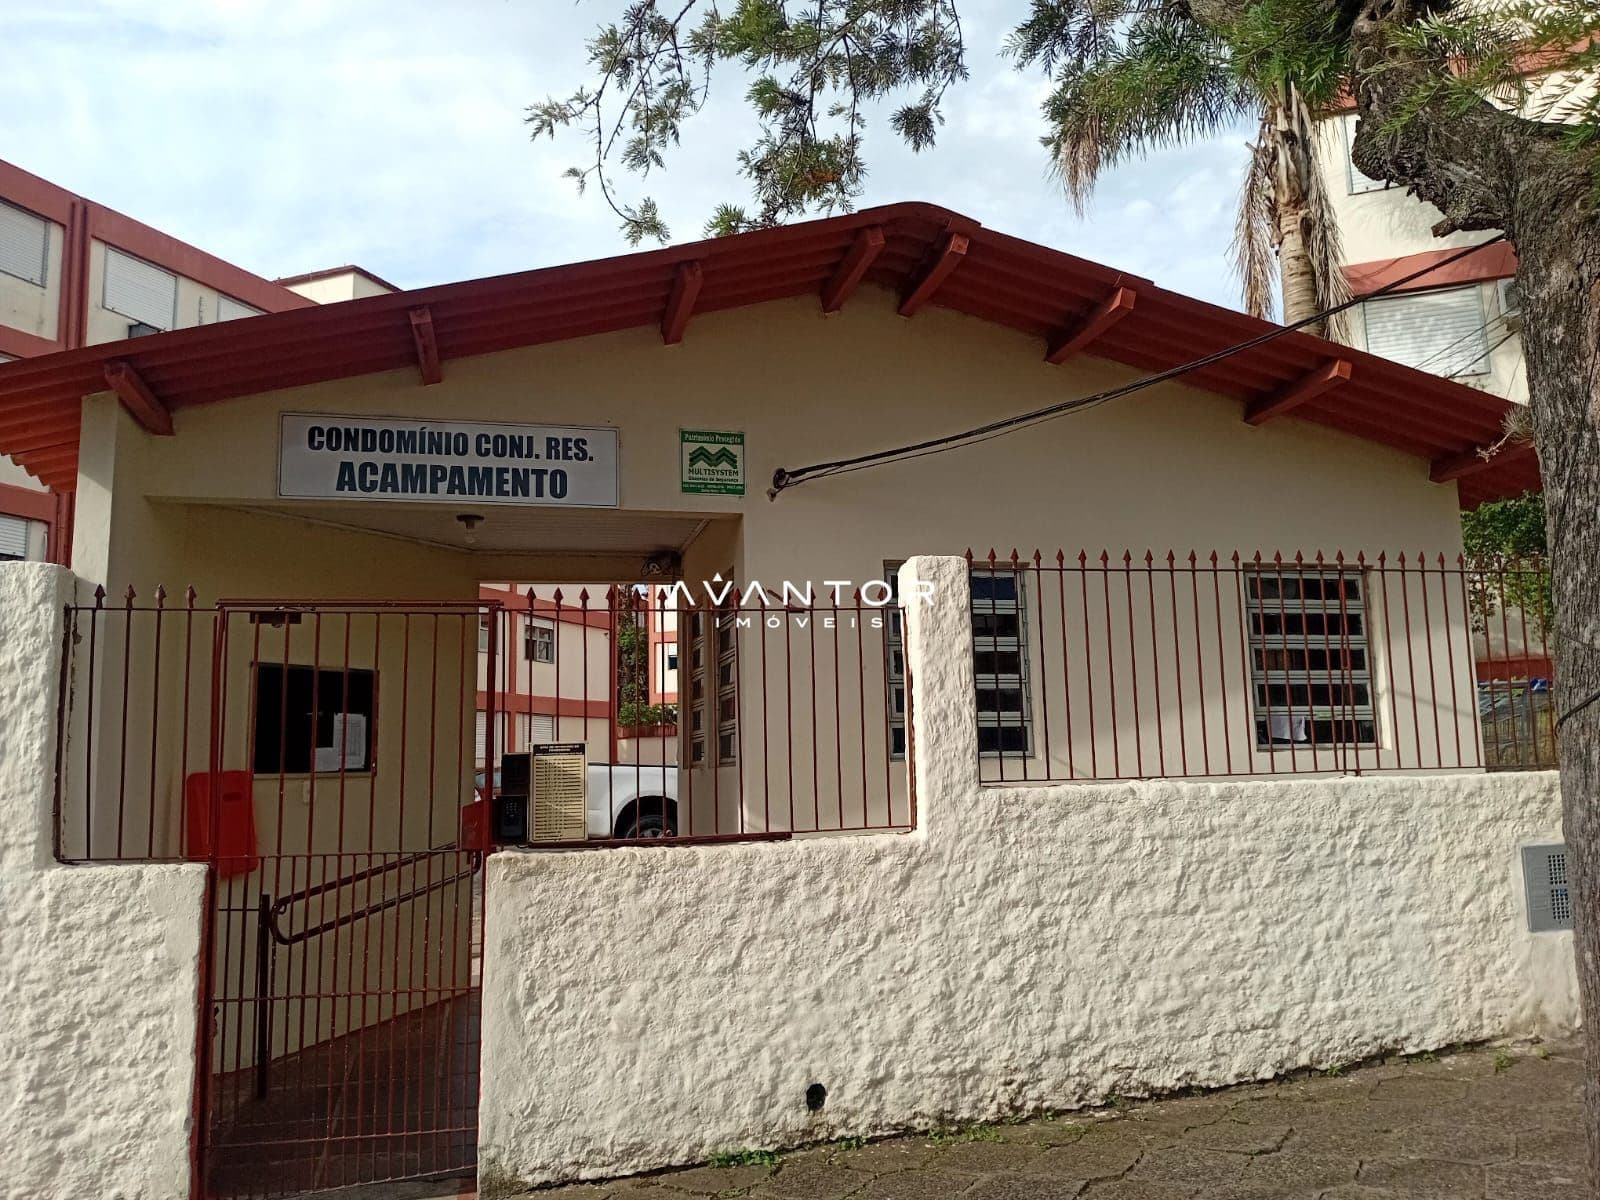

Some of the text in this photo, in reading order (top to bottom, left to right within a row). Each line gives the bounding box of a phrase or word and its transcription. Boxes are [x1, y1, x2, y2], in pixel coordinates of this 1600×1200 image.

[308, 426, 594, 462] CONDOMÍNIO CONJ. RES.
[336, 461, 568, 499] ACAMPAMENTO
[688, 468, 739, 477] MULTISYSTEM
